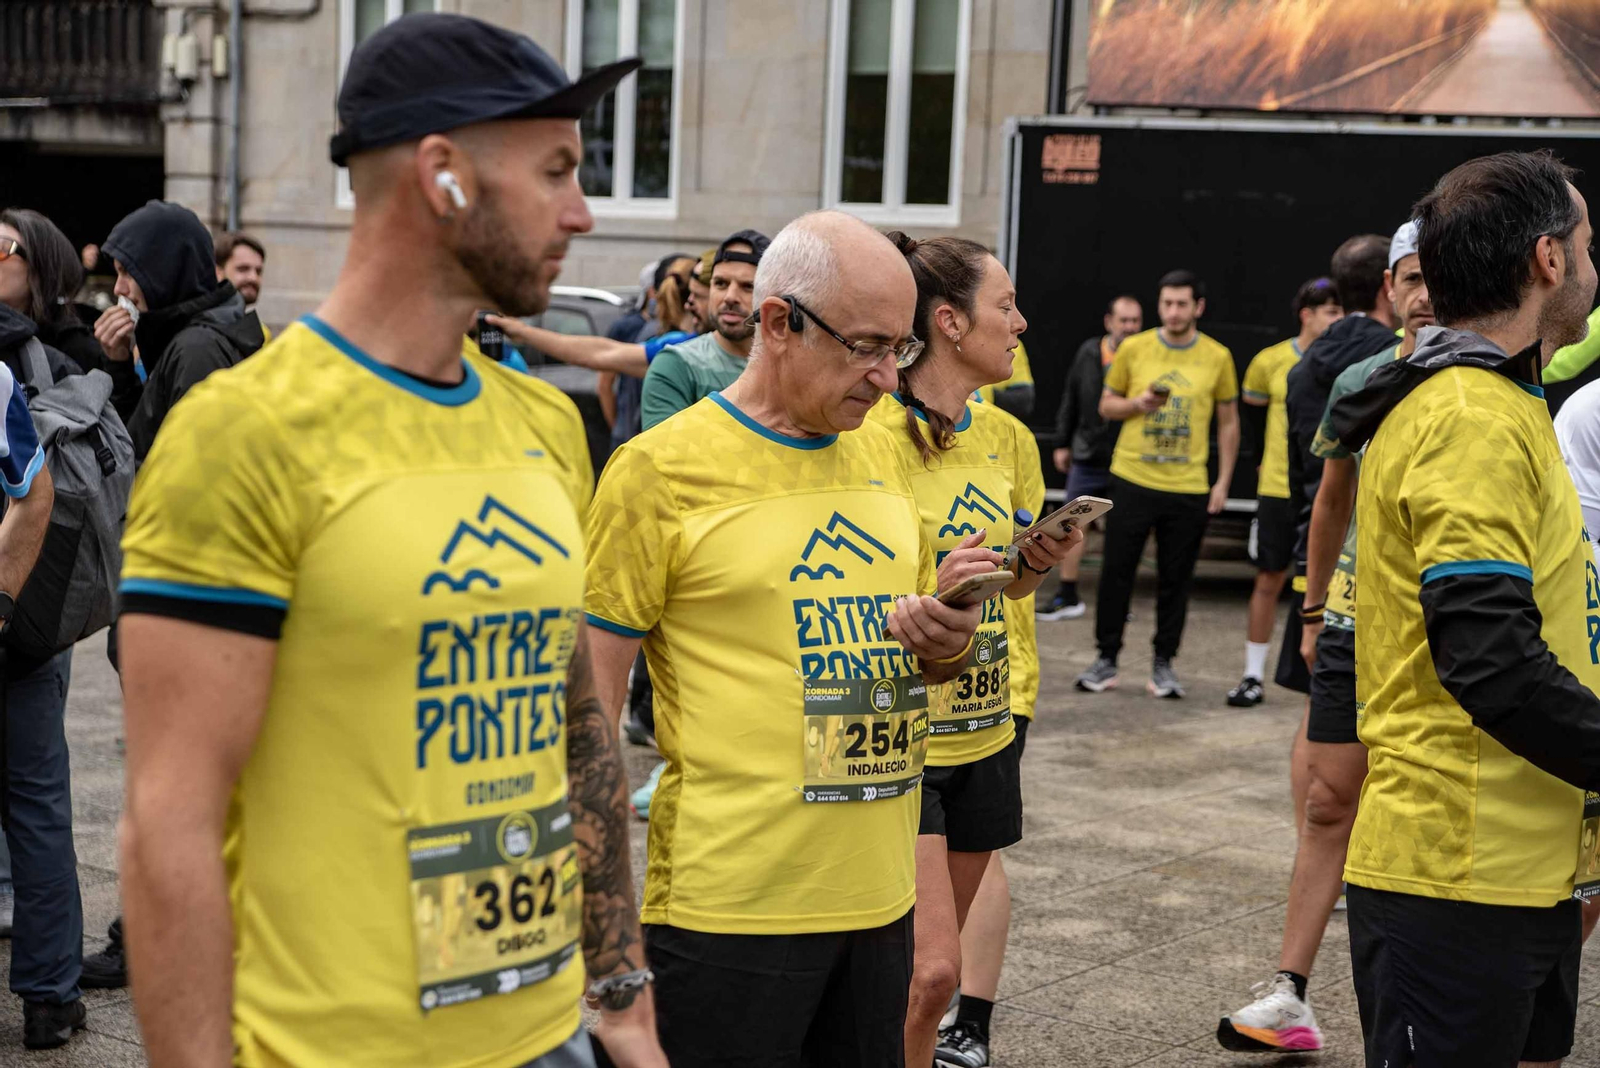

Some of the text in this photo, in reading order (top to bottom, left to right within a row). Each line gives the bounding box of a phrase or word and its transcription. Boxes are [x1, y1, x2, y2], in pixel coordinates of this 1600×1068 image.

[417, 608, 561, 689] ENTRE
[805, 687, 851, 695] XORNADA 3
[957, 667, 1000, 700] 388
[952, 702, 983, 714] MARIA
[416, 681, 567, 770] PONTES
[845, 720, 909, 758] 254
[913, 716, 927, 734] 10K
[847, 760, 907, 776] INDALECIO
[475, 866, 556, 931] 362
